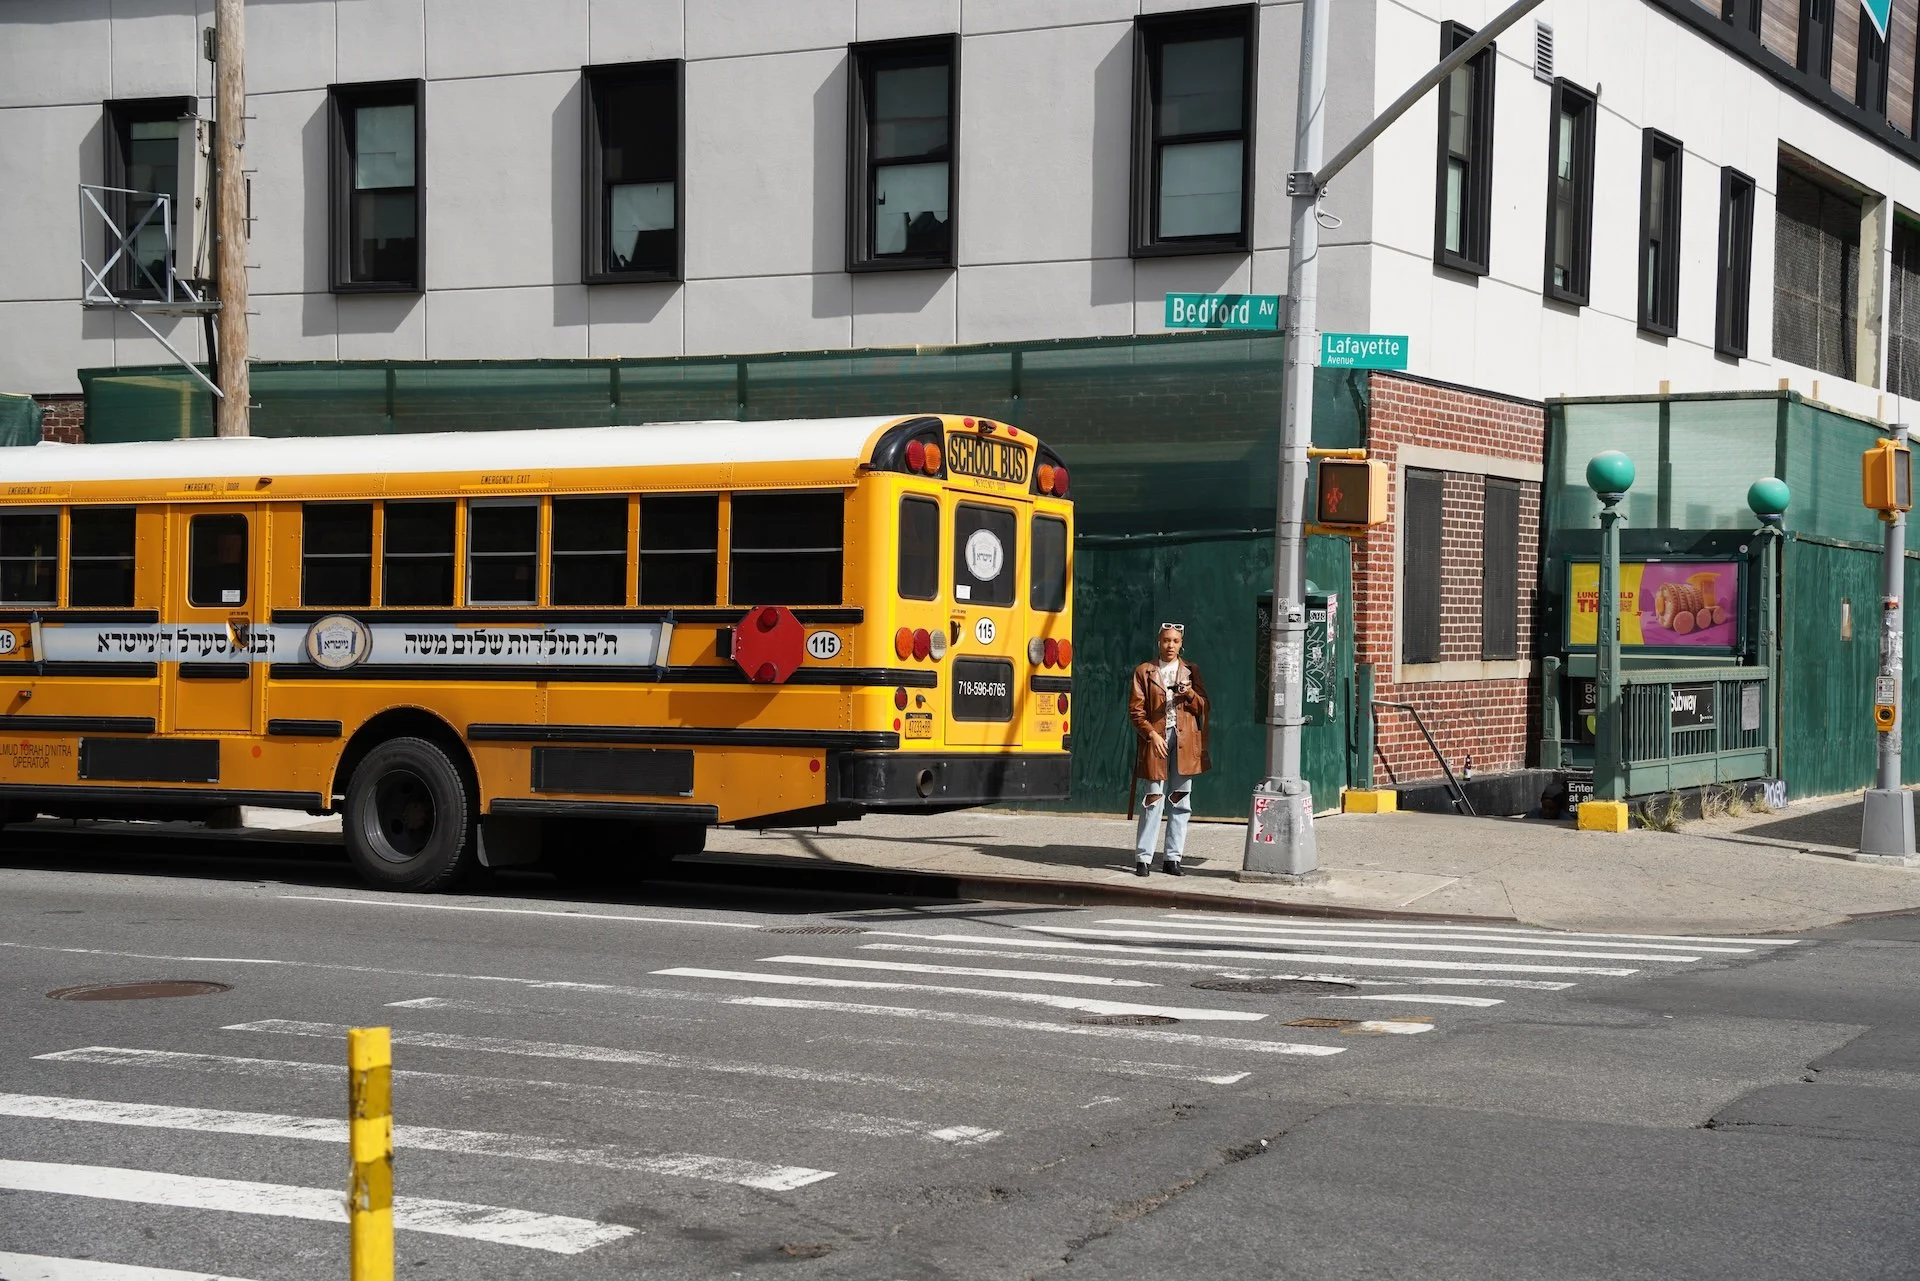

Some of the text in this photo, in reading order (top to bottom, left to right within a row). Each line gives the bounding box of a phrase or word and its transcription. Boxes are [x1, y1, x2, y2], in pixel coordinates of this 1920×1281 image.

[1172, 297, 1275, 324] Bedford Av
[1327, 336, 1400, 358] Lafayette
[1327, 355, 1354, 366] Avenue
[950, 436, 1023, 481] SCHOOL BUS
[979, 623, 993, 639] 115
[0, 634, 12, 649] 15
[404, 633, 448, 656] משה
[451, 629, 503, 656] שלום
[812, 636, 835, 653] 115
[958, 680, 1006, 697] 718-596-6765
[1671, 691, 1697, 715] Subway
[20, 744, 44, 756] TORAH
[12, 756, 50, 769] OPERATOR
